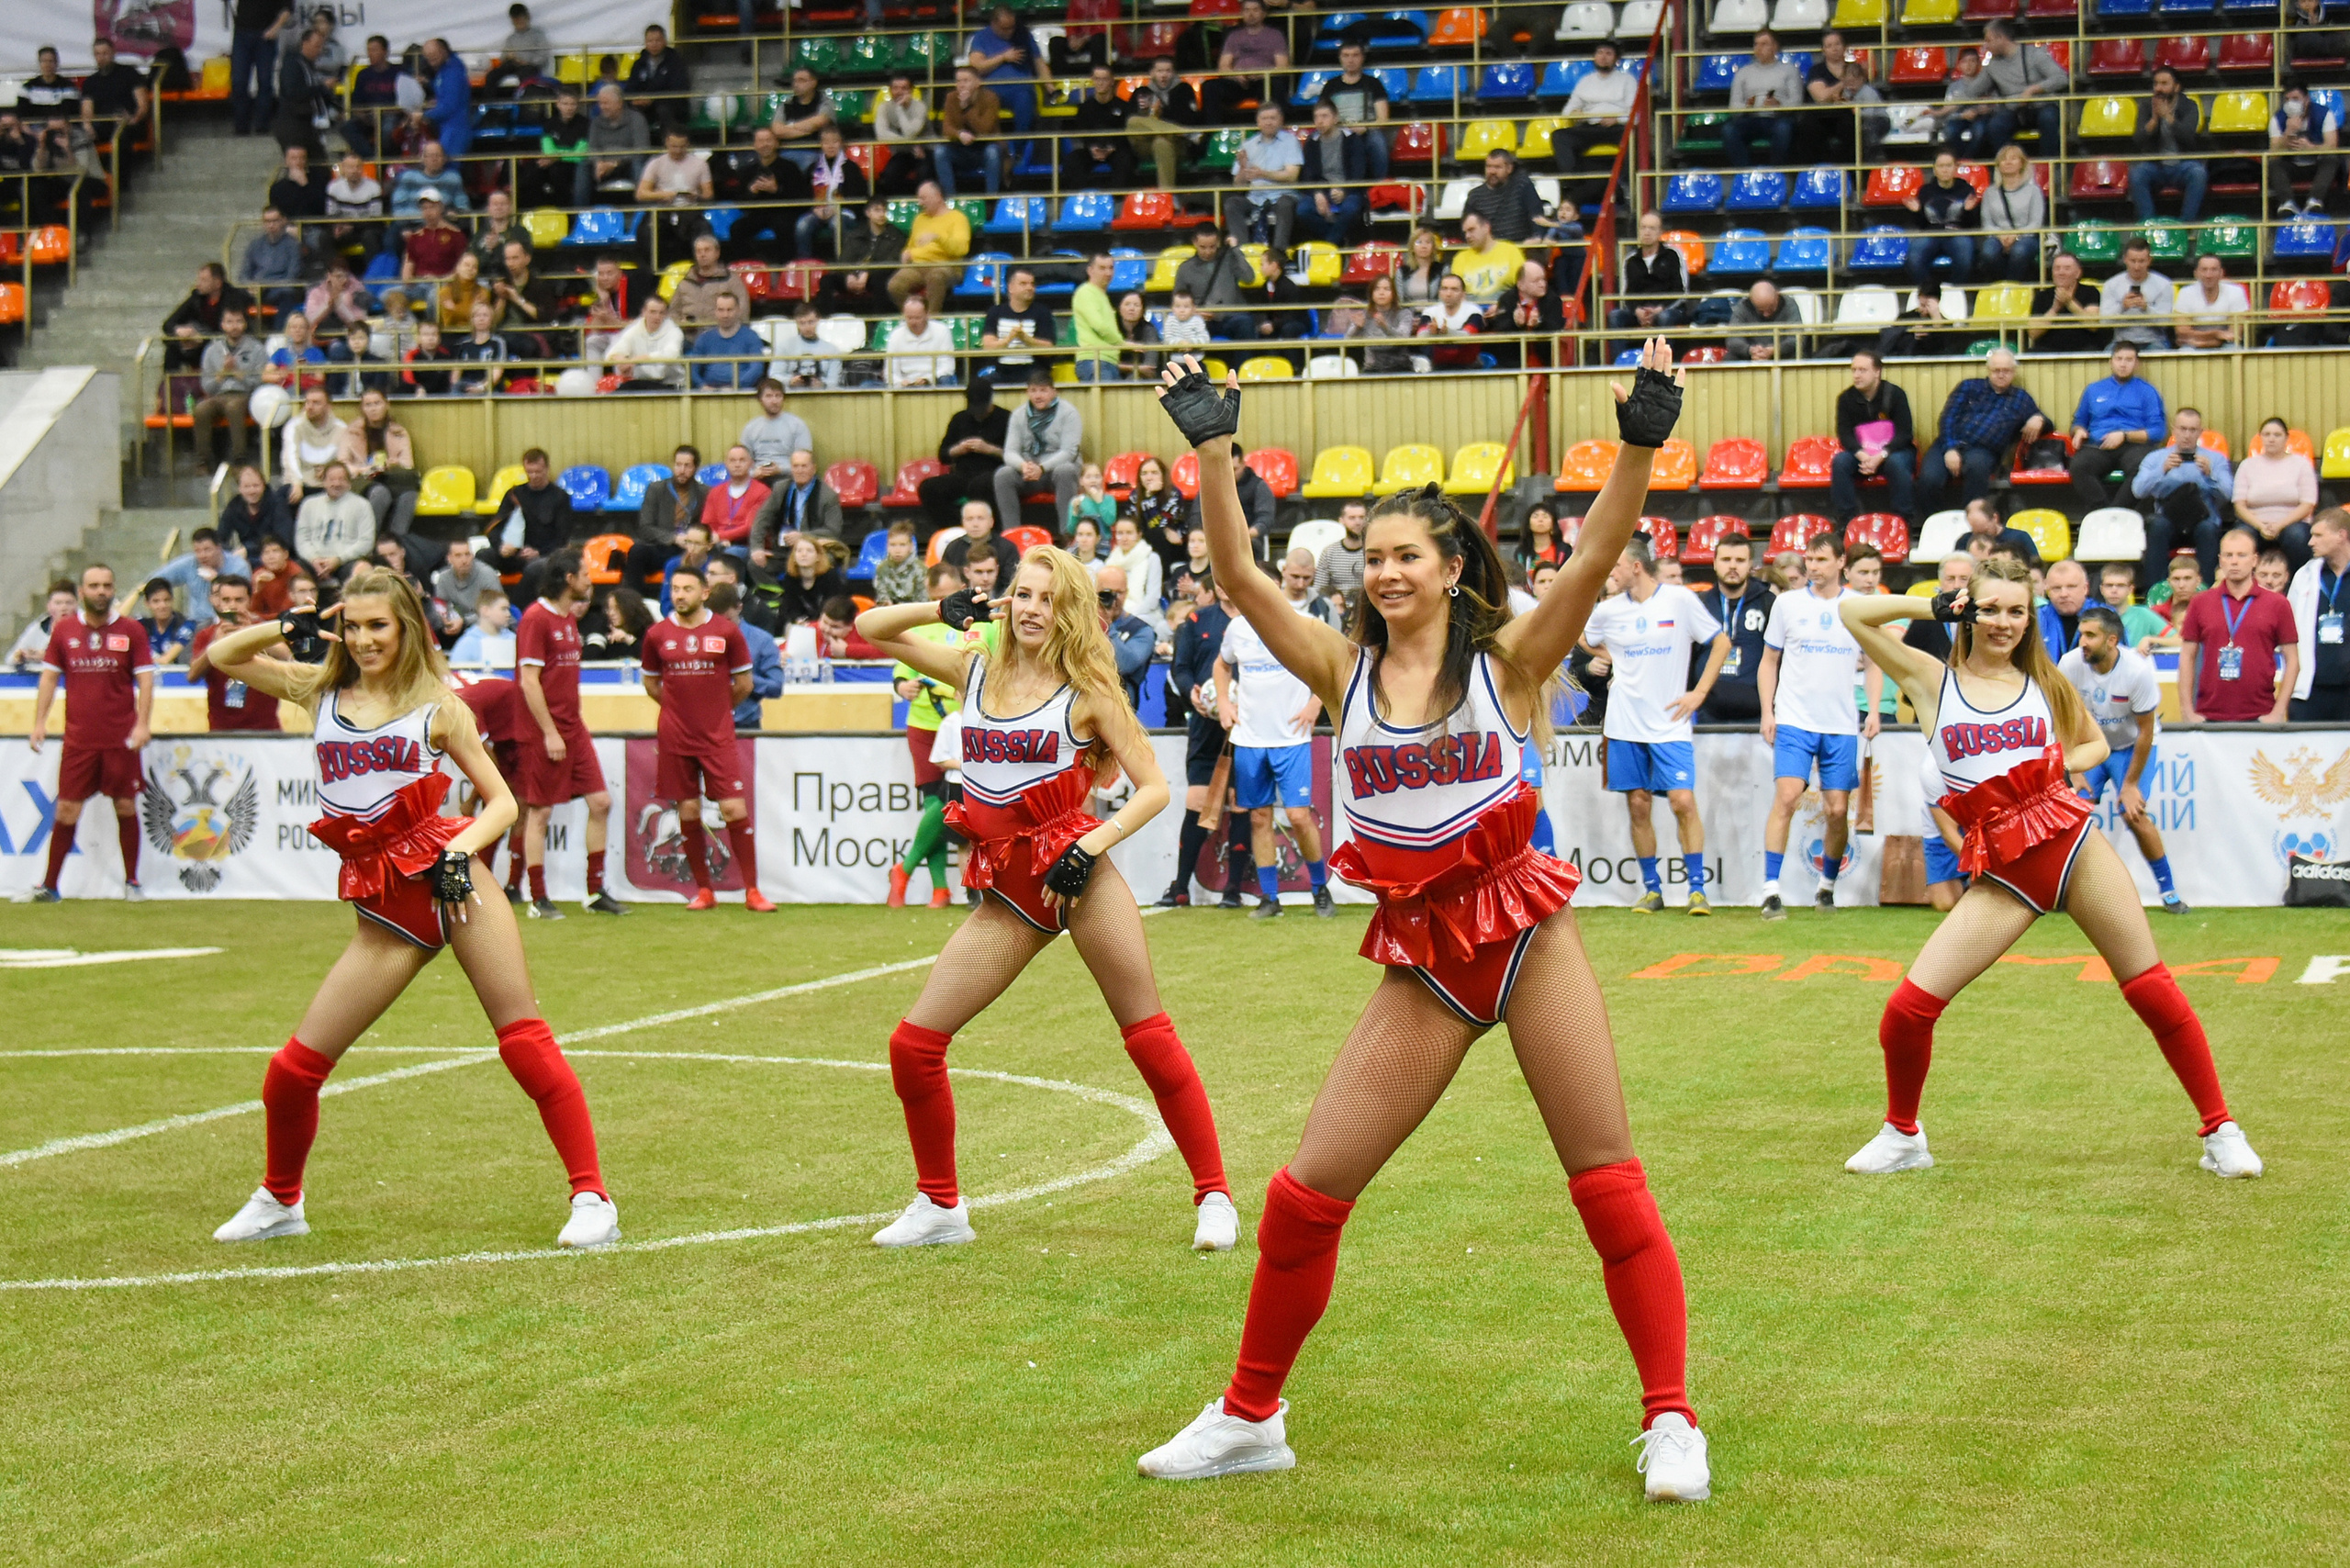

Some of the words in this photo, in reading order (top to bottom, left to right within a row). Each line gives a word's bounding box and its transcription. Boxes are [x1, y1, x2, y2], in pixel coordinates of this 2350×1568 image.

[1744, 608, 1766, 633] 87
[1624, 645, 1672, 658] NewSport
[1800, 644, 1852, 655] NewSport
[1941, 716, 2047, 763] RUSSIA
[316, 735, 420, 786] RUSSIA
[1344, 731, 1504, 801] RUSSIA
[2291, 863, 2350, 881] adidas
